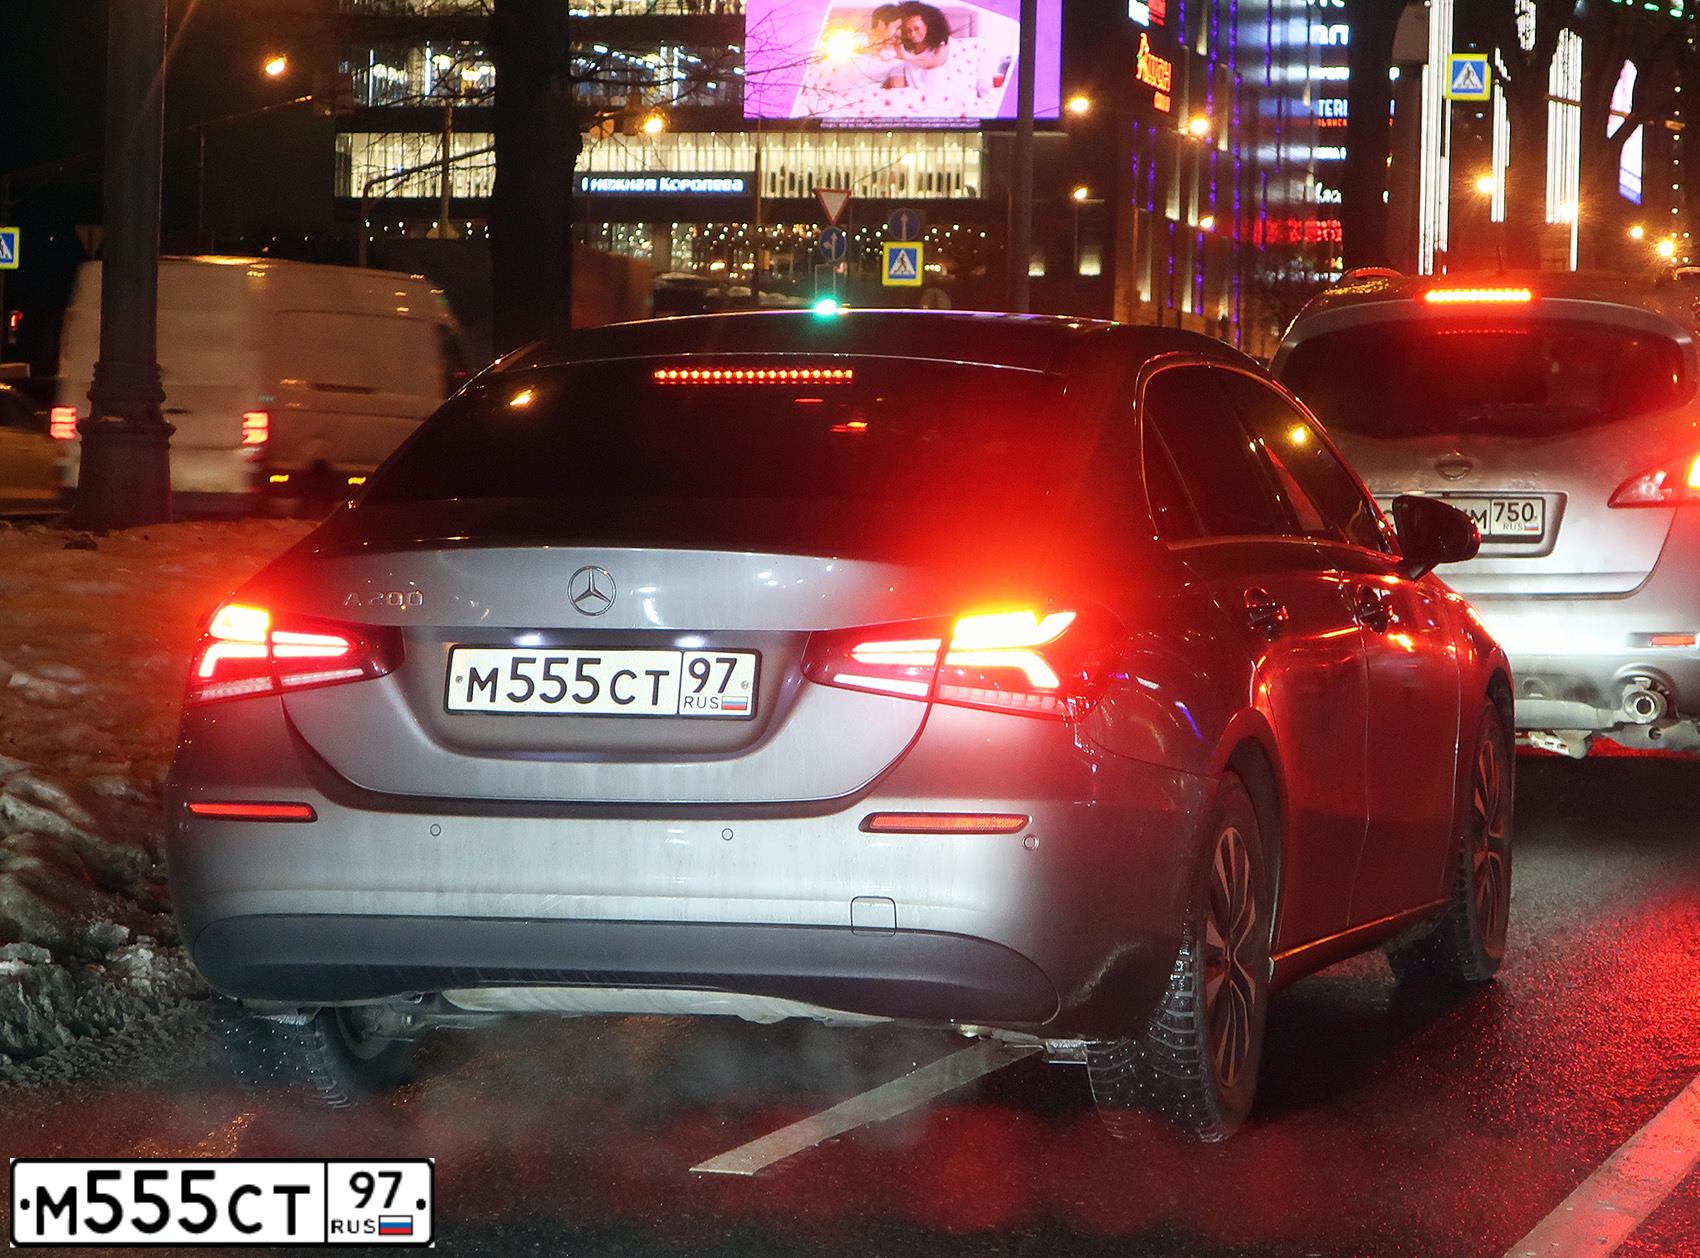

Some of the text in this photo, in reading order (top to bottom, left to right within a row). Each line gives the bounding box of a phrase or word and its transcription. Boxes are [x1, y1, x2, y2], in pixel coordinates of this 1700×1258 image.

[1493, 502, 1535, 523] 750
[1503, 523, 1523, 531] RUS
[368, 592, 423, 607] 200
[688, 657, 738, 694] 97
[683, 696, 719, 710] RUS
